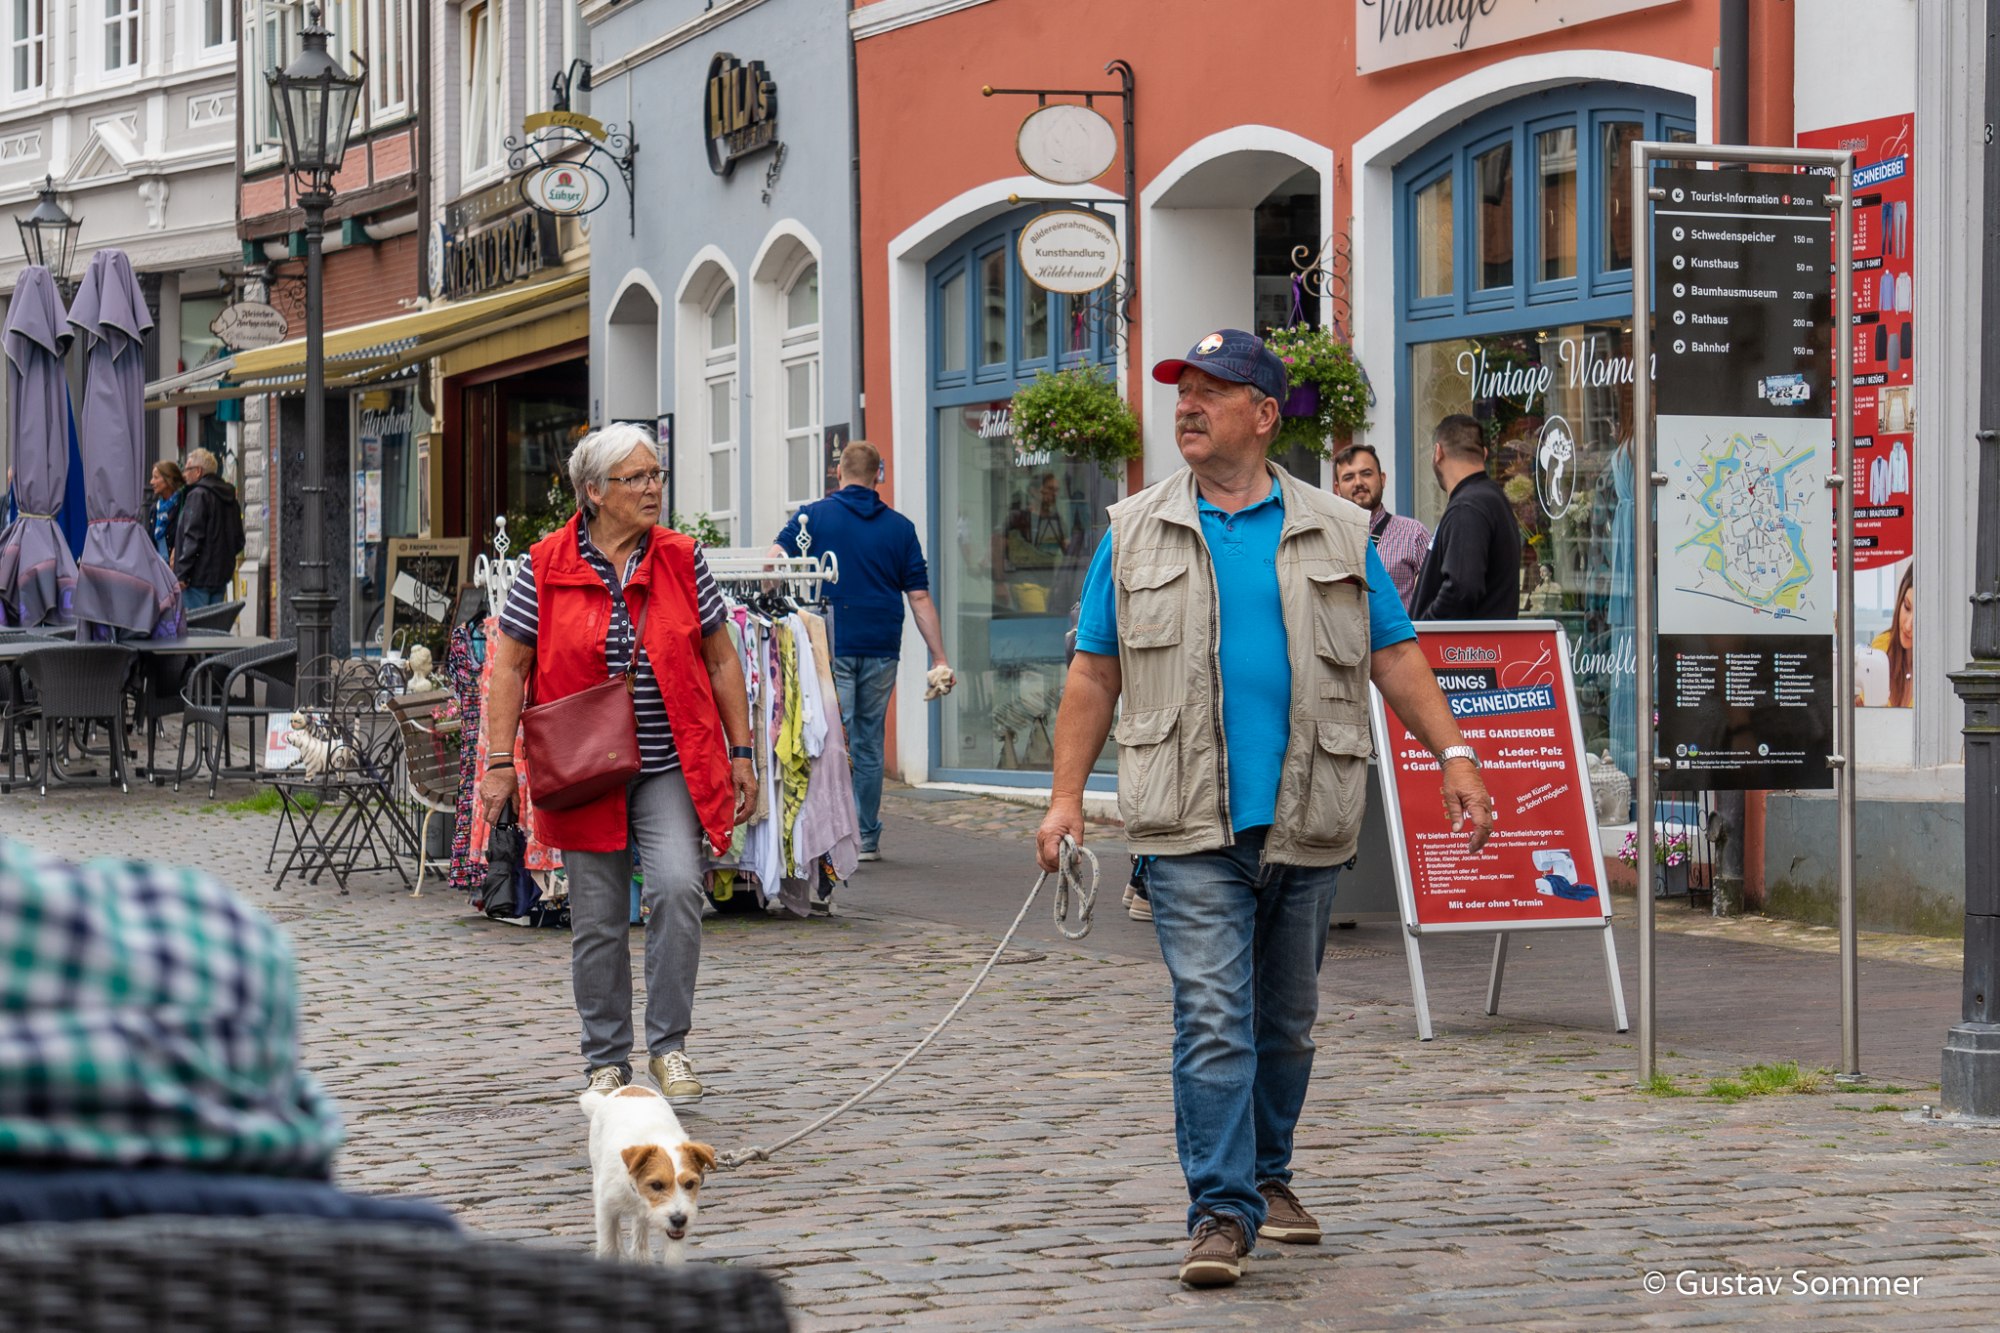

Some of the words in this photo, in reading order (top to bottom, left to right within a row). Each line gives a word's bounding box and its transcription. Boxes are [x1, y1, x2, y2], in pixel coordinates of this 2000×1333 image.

[1852, 160, 1904, 188] SCHNEIDEREI
[548, 189, 581, 202] Lübzer
[1691, 191, 1779, 205] Tourist-Information
[1792, 197, 1806, 206] 200
[1029, 222, 1111, 246] Bildereinrahmungen
[1691, 229, 1776, 243] Schwedenspeicher
[1793, 235, 1806, 243] 150
[446, 214, 543, 302] MENDOZA
[1035, 248, 1105, 260] Kunsthandlung
[1691, 258, 1739, 270] Kunsthaus
[1796, 264, 1806, 272] 50
[1691, 285, 1778, 299] Baumhausmuseum
[1793, 291, 1806, 300] 200
[1691, 313, 1729, 325] Rathaus
[1793, 319, 1806, 327] 200
[1691, 341, 1730, 353] Bahnhof
[1793, 347, 1806, 355] 950
[1457, 348, 1553, 413] Vintage
[361, 405, 413, 437] Fleischerei
[1445, 646, 1496, 660] Chikho
[1437, 675, 1487, 690] RUNGS
[1451, 690, 1551, 715] SCHNEIDEREI
[1460, 729, 1486, 739] IHRE
[1489, 728, 1556, 738] GARDEROBE
[1505, 747, 1538, 757] Leder-
[1541, 746, 1563, 756] Pelz
[1410, 761, 1441, 771] Gardi
[1484, 760, 1566, 770] Maßanfertigung
[1516, 792, 1533, 803] Hose
[1531, 783, 1552, 796] Kürzen
[1516, 806, 1526, 814] ab
[1525, 796, 1543, 810] Sofort
[1543, 783, 1569, 801] möglich!
[1416, 832, 1427, 840] Wir
[1450, 831, 1469, 839] Ihnen
[1500, 829, 1553, 838] Dienstleistungen
[1449, 901, 1463, 909] Mit
[1465, 900, 1486, 909] oder
[1488, 899, 1510, 907] ohne
[1512, 898, 1543, 907] Termin
